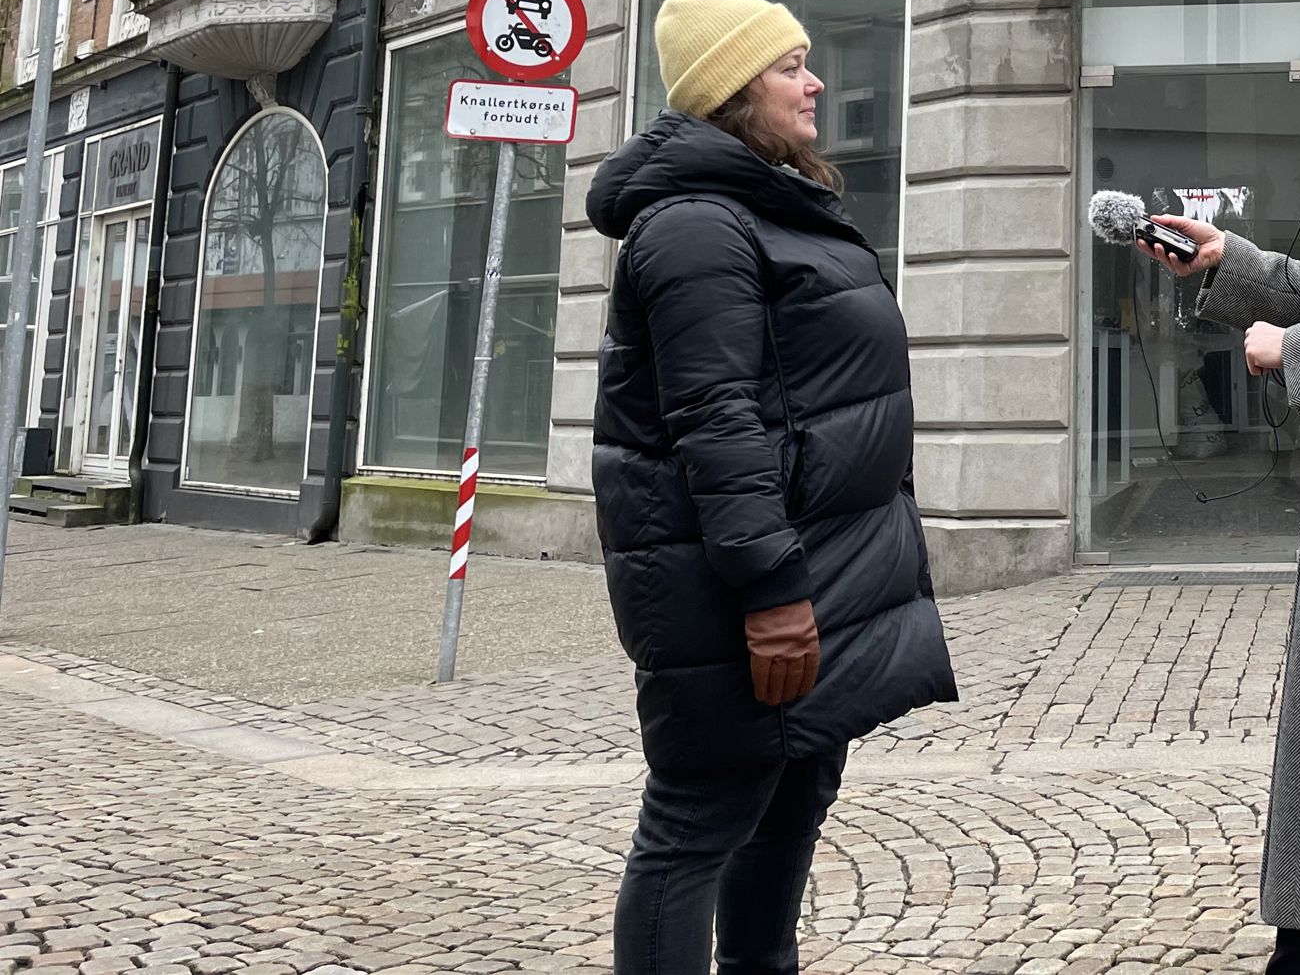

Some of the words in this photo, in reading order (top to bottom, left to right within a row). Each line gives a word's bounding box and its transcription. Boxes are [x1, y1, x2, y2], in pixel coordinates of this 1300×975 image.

[460, 95, 566, 111] Knallertkørsel
[484, 111, 539, 124] forbudt
[109, 141, 150, 179] GRAND
